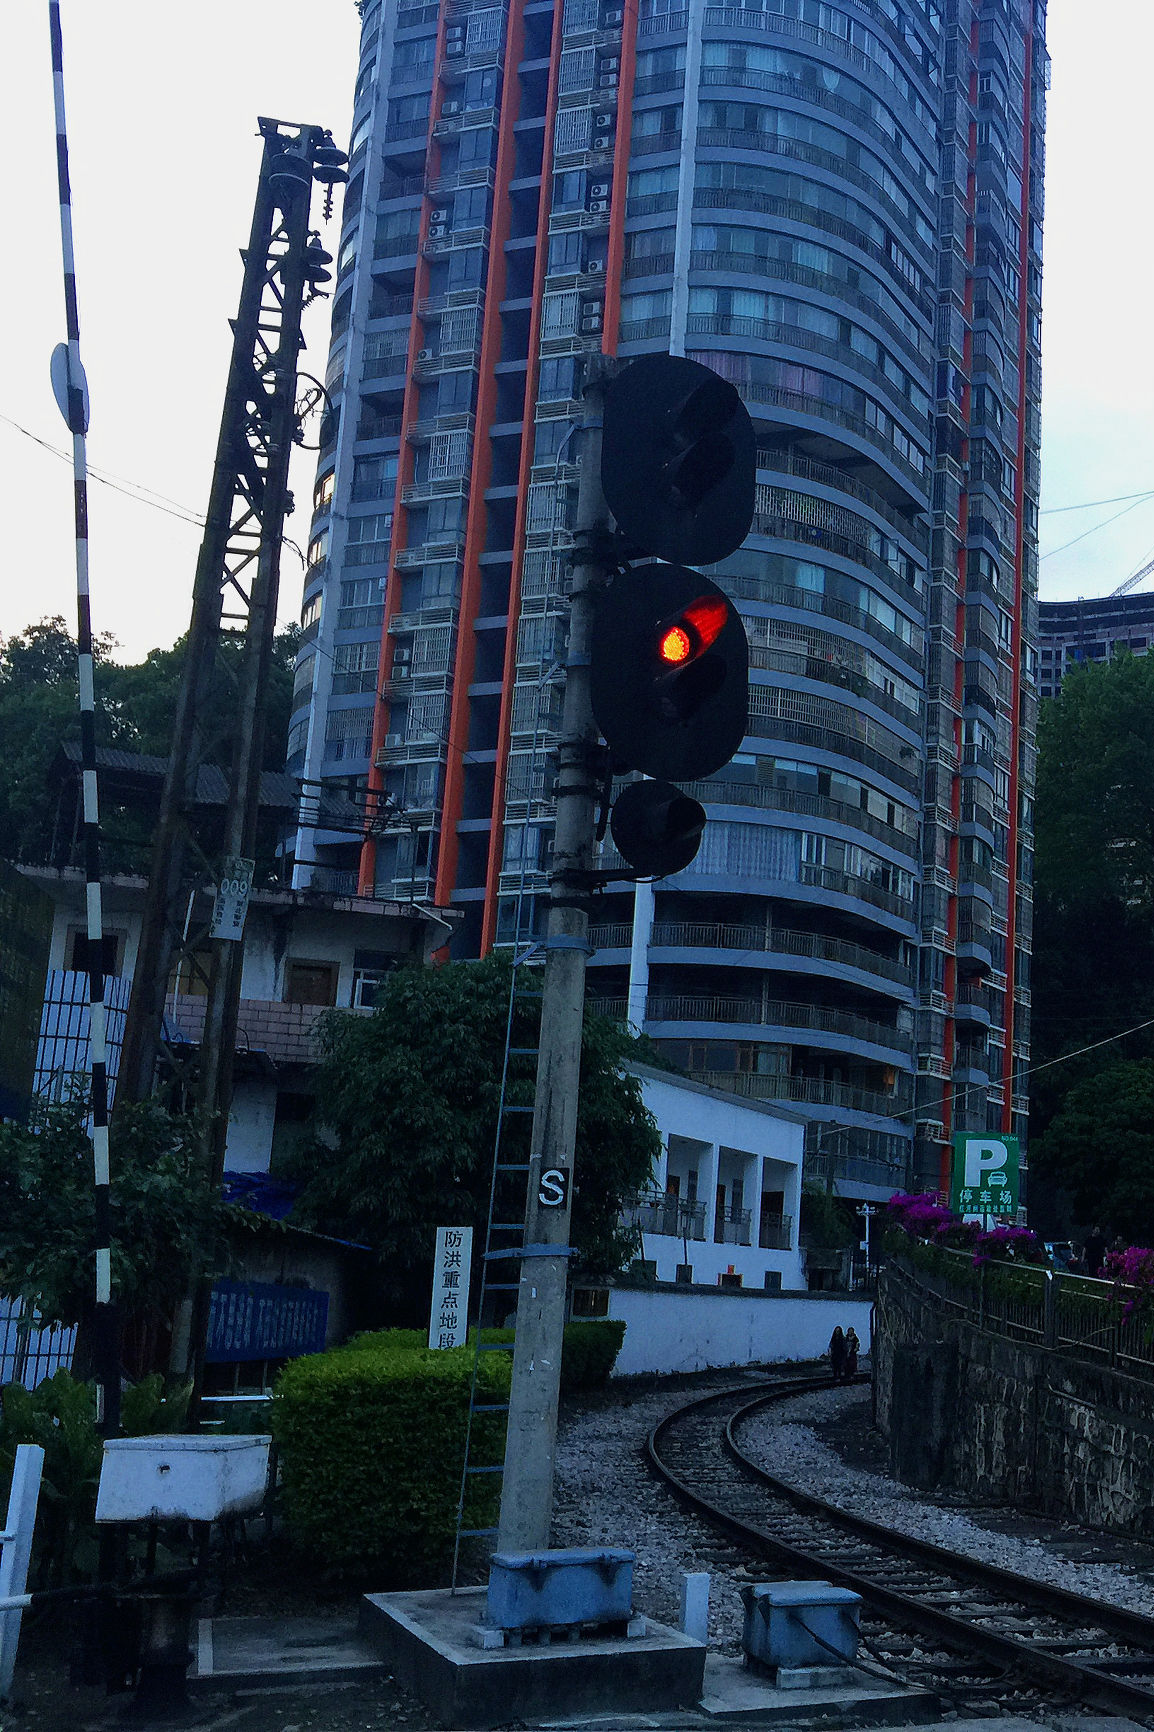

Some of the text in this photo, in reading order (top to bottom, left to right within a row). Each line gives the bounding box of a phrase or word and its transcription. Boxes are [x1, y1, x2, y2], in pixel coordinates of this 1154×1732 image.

[964, 1139, 1008, 1187] P
[539, 1169, 565, 1206] S
[959, 1188, 1012, 1205] 停车场
[438, 1230, 464, 1351] 防洪重点地段
